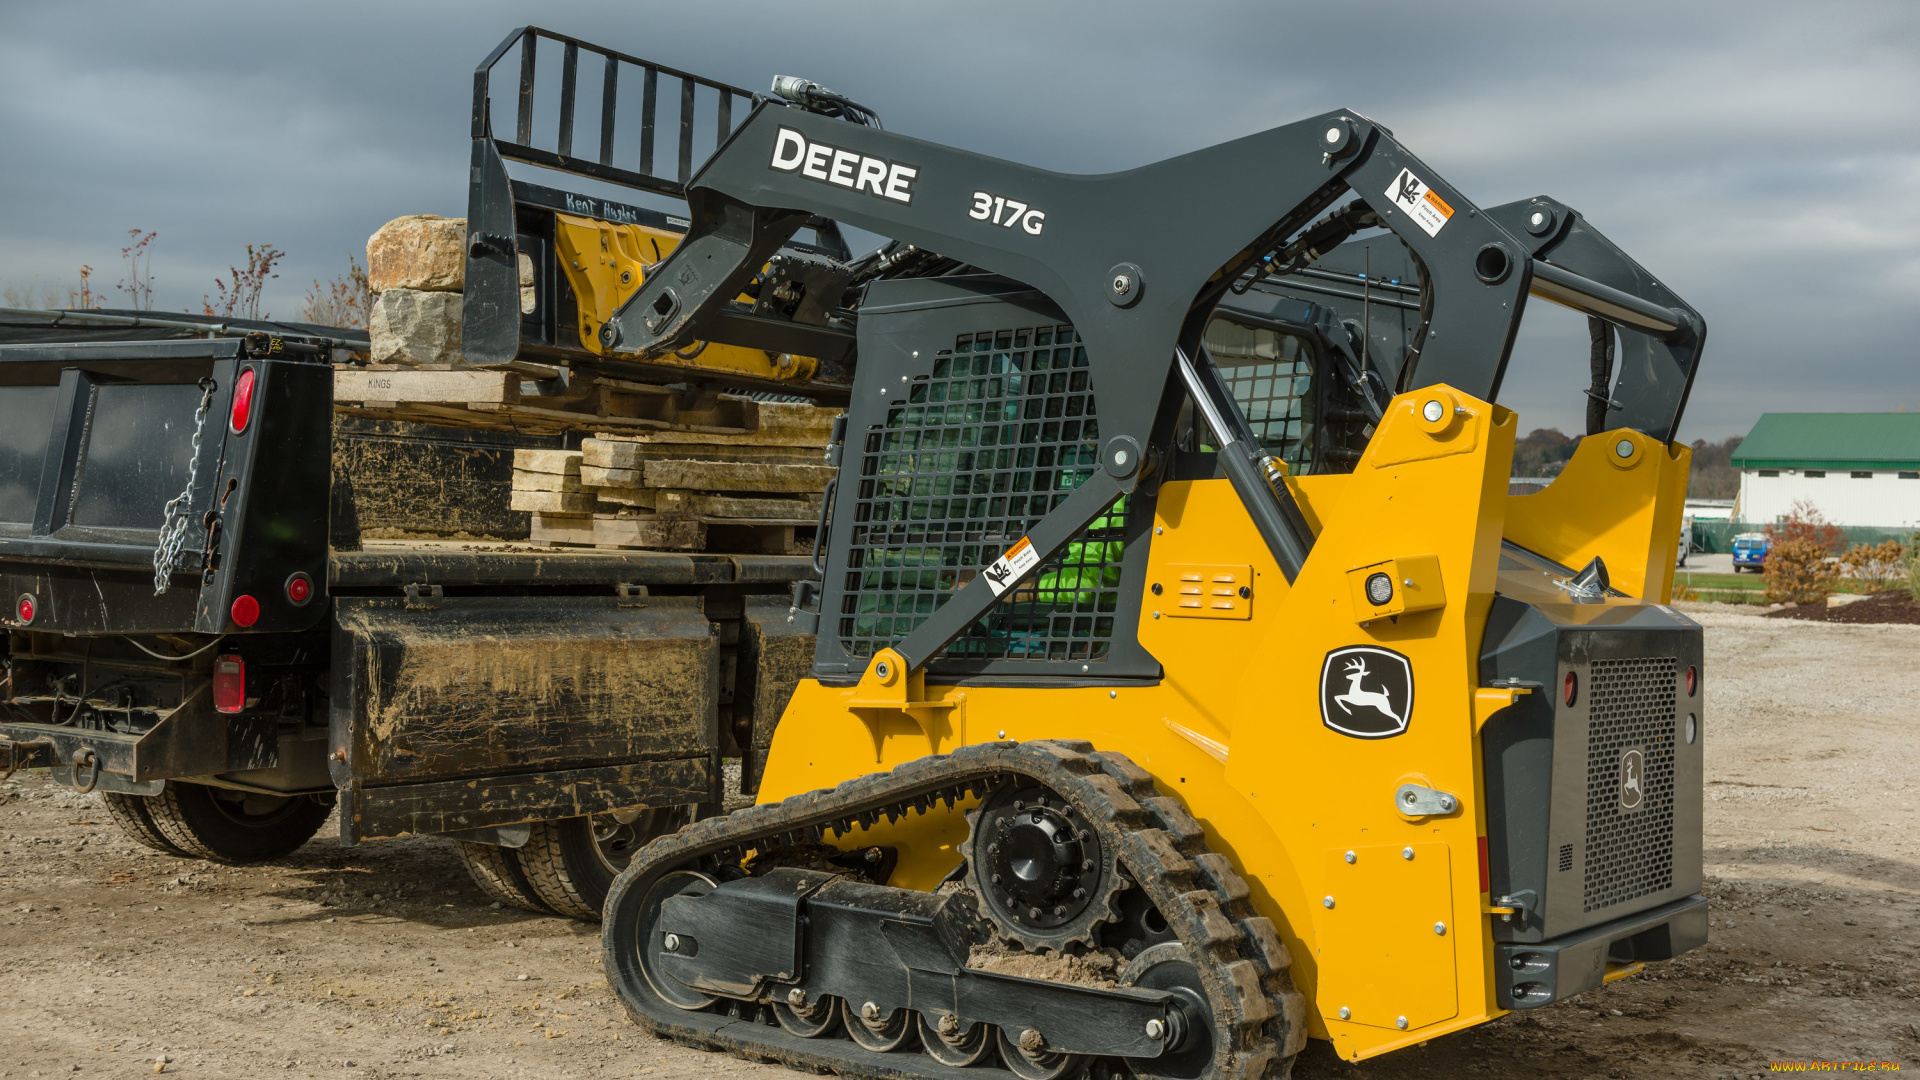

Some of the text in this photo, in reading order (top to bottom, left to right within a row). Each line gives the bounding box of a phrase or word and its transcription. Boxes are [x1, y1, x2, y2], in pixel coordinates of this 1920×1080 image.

[771, 127, 917, 203] DEERE
[968, 191, 1046, 236] 317G
[1421, 204, 1441, 223] Pinch Area
[1430, 196, 1451, 216] WARNING
[367, 378, 392, 389] KINGS
[1011, 539, 1028, 555] WARNING
